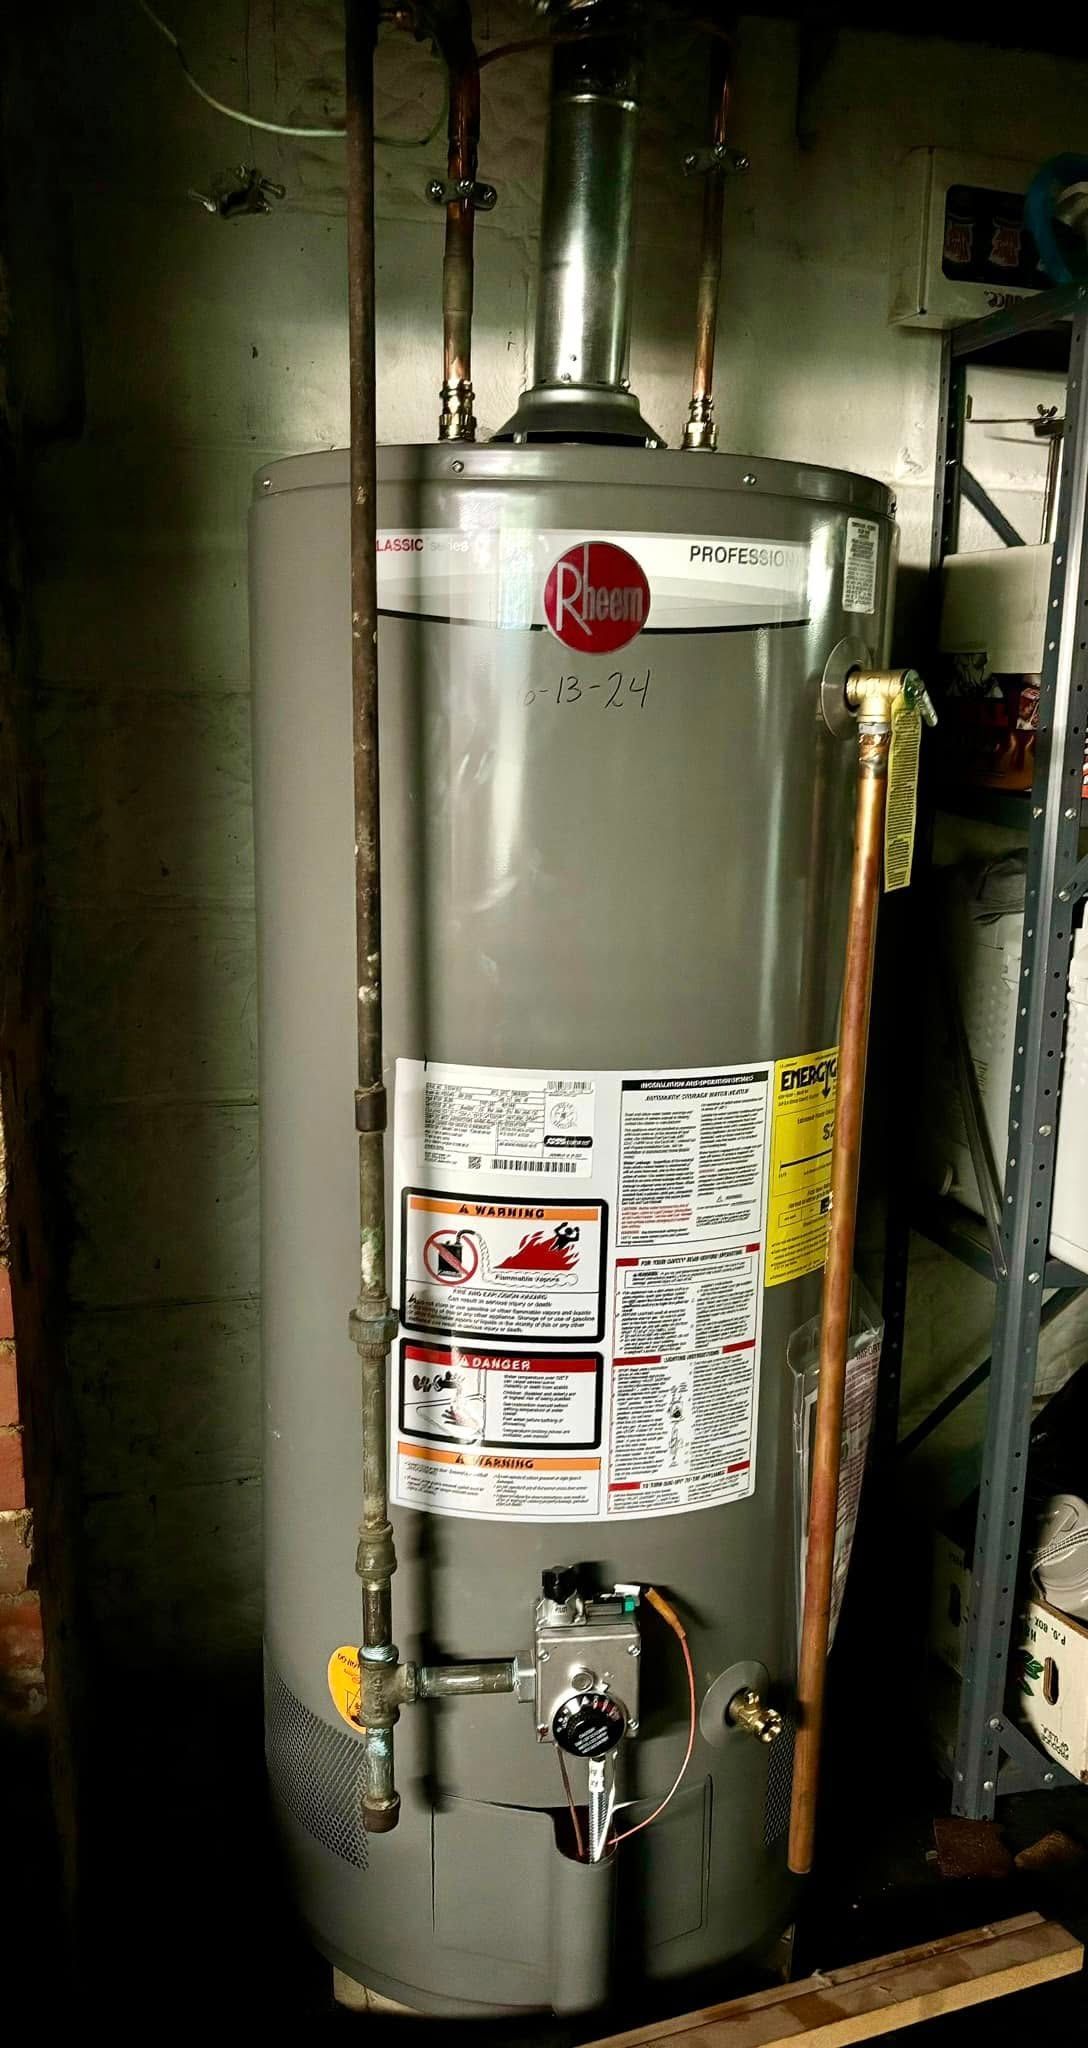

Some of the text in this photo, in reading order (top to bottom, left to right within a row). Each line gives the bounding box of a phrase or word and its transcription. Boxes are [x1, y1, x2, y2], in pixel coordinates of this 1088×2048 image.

[556, 543, 643, 636] Rheem
[475, 1205, 545, 1218] WARNING
[494, 1274, 533, 1282] Flammable
[472, 1355, 531, 1371] DANGER
[1034, 1616, 1048, 1634] BOX
